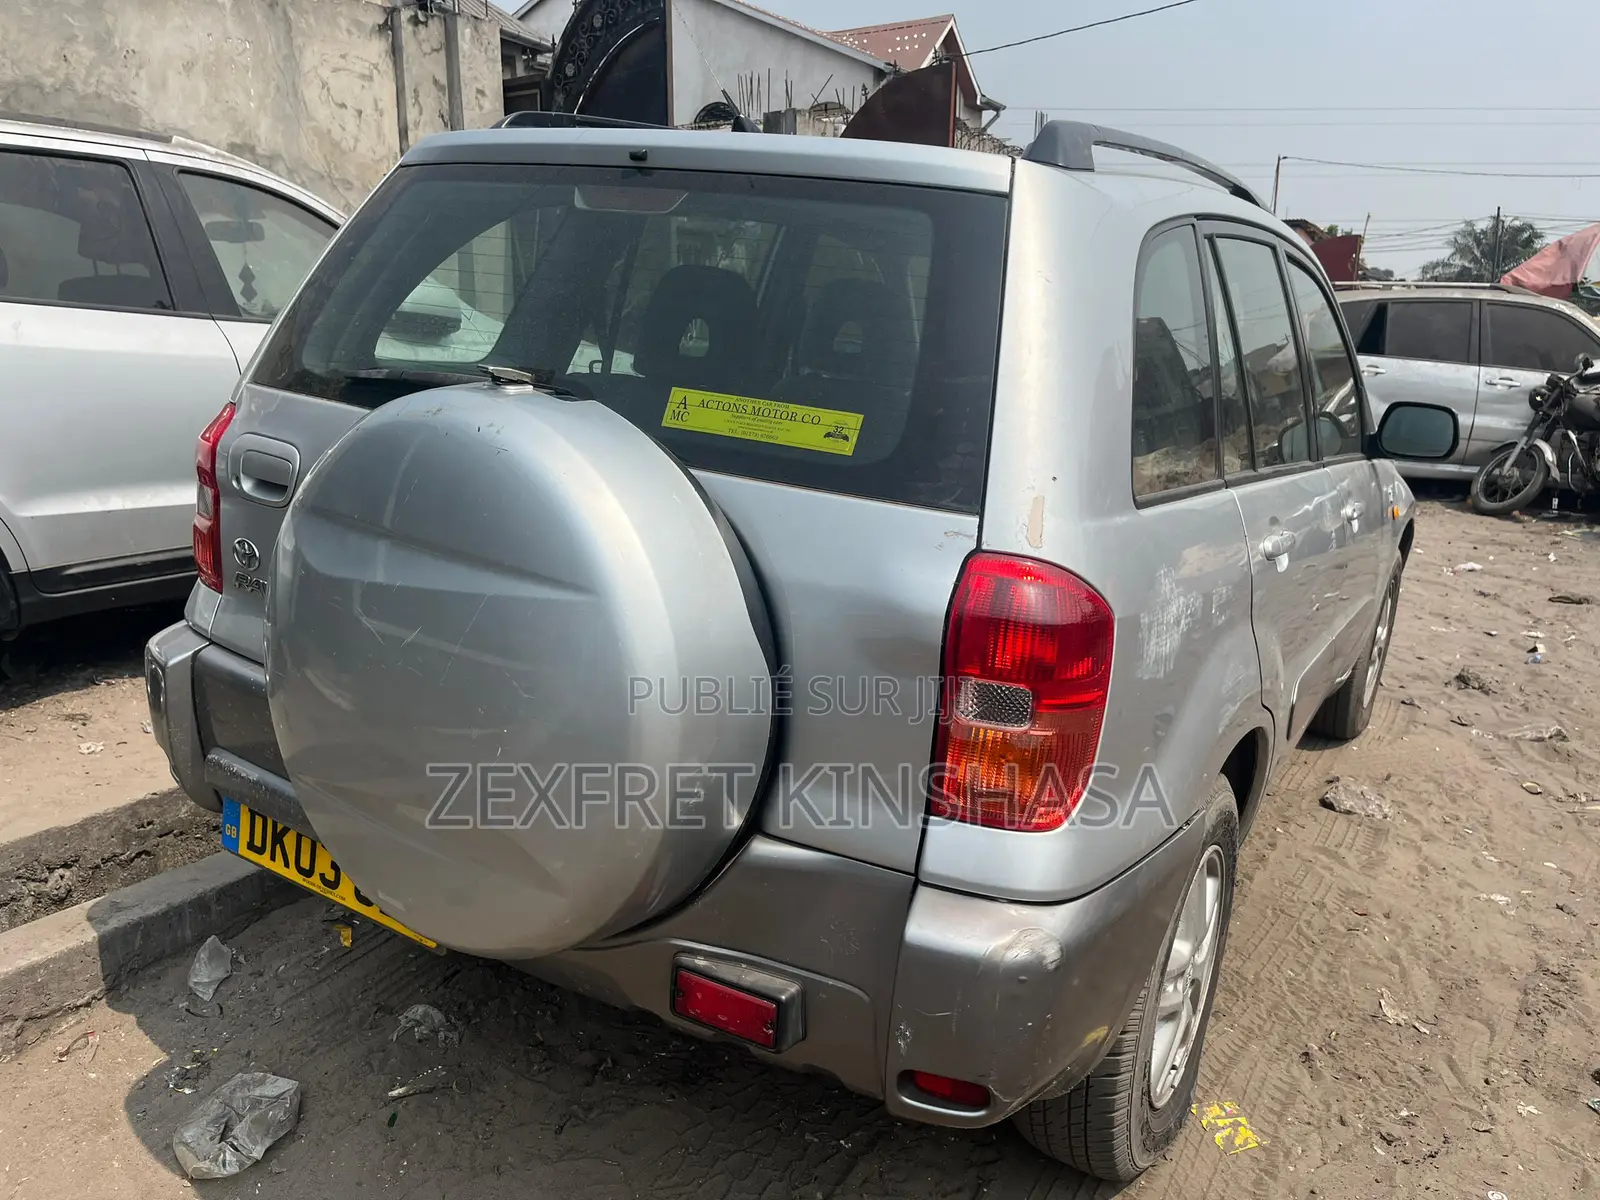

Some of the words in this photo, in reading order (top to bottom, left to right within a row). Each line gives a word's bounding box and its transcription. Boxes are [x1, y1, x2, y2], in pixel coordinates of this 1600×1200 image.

[677, 395, 688, 410] A
[774, 402, 790, 410] FROM
[669, 409, 690, 422] MC
[697, 398, 749, 414] ACTONS
[751, 405, 798, 422] MOTOR
[801, 413, 821, 425] CO
[833, 425, 844, 434] 32
[225, 823, 237, 838] GB
